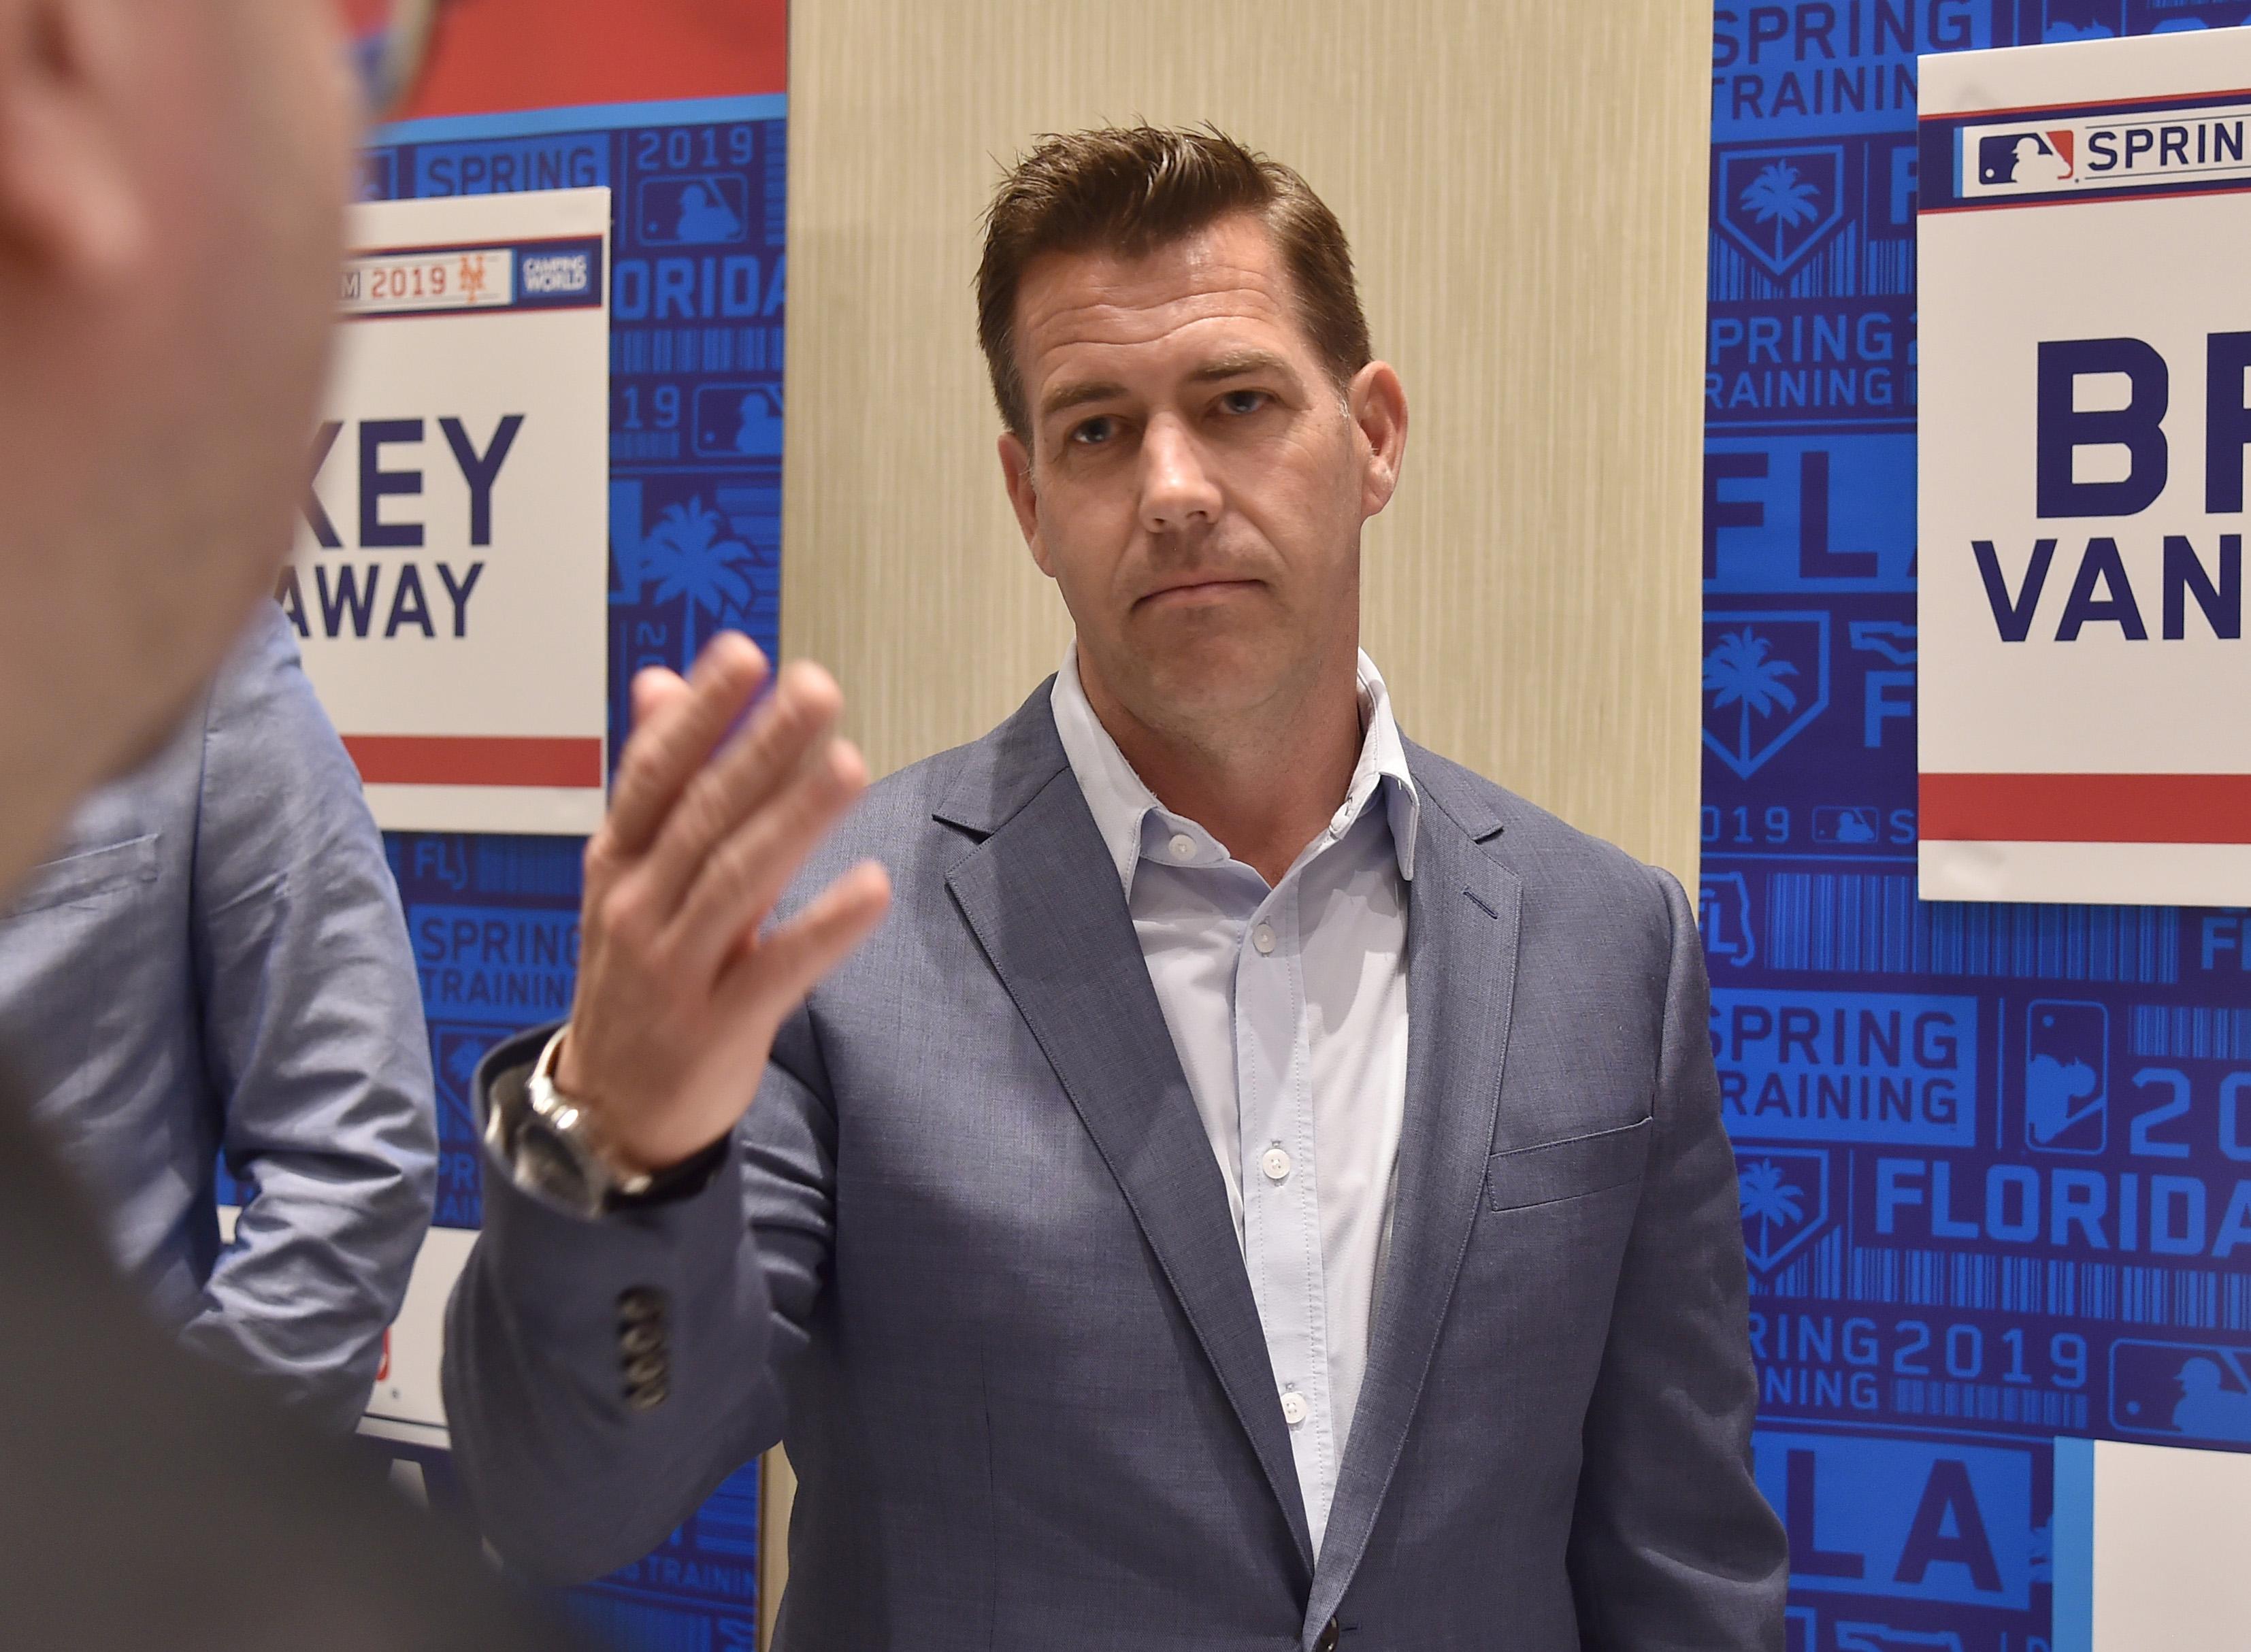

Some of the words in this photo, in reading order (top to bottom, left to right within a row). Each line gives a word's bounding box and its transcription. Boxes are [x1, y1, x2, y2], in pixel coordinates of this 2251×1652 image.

[1712, 0, 1973, 68] SPRING
[637, 125, 753, 170] 2019
[2087, 121, 2244, 171] SPRIN
[427, 148, 595, 199] SPRING
[370, 267, 447, 297] 2019
[524, 274, 587, 292] WORLD
[1710, 312, 1893, 366] PRING
[622, 385, 679, 430] 19
[1701, 450, 1918, 580] FL
[274, 561, 484, 639] AWAY
[1971, 534, 2243, 642] VAN
[1894, 1321, 2088, 1389] 2019
[1786, 1449, 2003, 1593] LA
